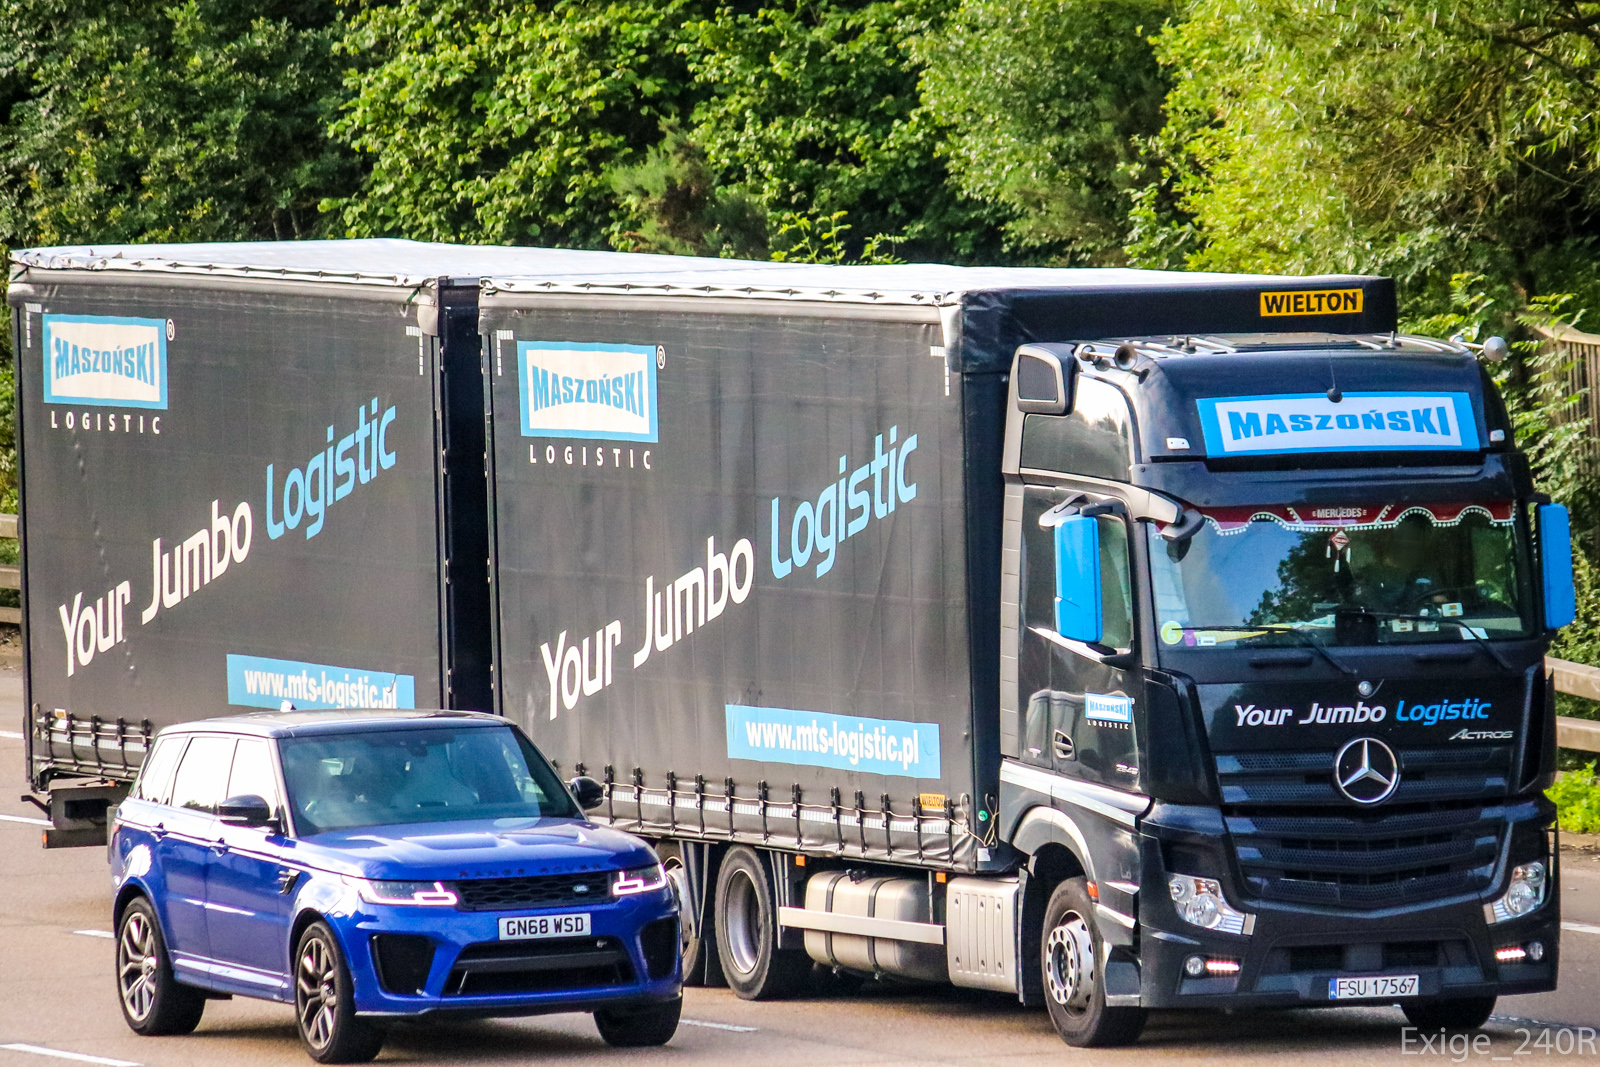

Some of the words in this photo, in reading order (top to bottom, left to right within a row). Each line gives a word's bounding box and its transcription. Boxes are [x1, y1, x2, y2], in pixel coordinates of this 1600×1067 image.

[1264, 292, 1358, 313] WIELTON
[55, 337, 155, 387] MASZOŃSKI
[532, 365, 645, 418] MASZOŃSKI
[51, 410, 161, 435] LOGISTIC
[1227, 406, 1451, 441] MASZOŃSKI
[529, 444, 652, 470] LOGISTIC
[59, 580, 131, 678] Your
[141, 499, 254, 626] Jumbo
[266, 397, 397, 541] Logistic
[540, 619, 622, 721] Your
[633, 535, 755, 669] Jumbo
[770, 425, 918, 579] Logistic
[1087, 720, 1129, 730] LOGISTIC
[1235, 704, 1293, 727] Your
[1299, 701, 1387, 725] Jumbo
[1395, 698, 1492, 726] Logistic
[745, 720, 919, 769] www.mts-logistic.pl
[1449, 728, 1514, 741] ACTROS
[506, 918, 549, 936] GN68
[553, 916, 585, 934] WSD
[1338, 981, 1367, 996] FSU
[1373, 978, 1416, 995] 17567
